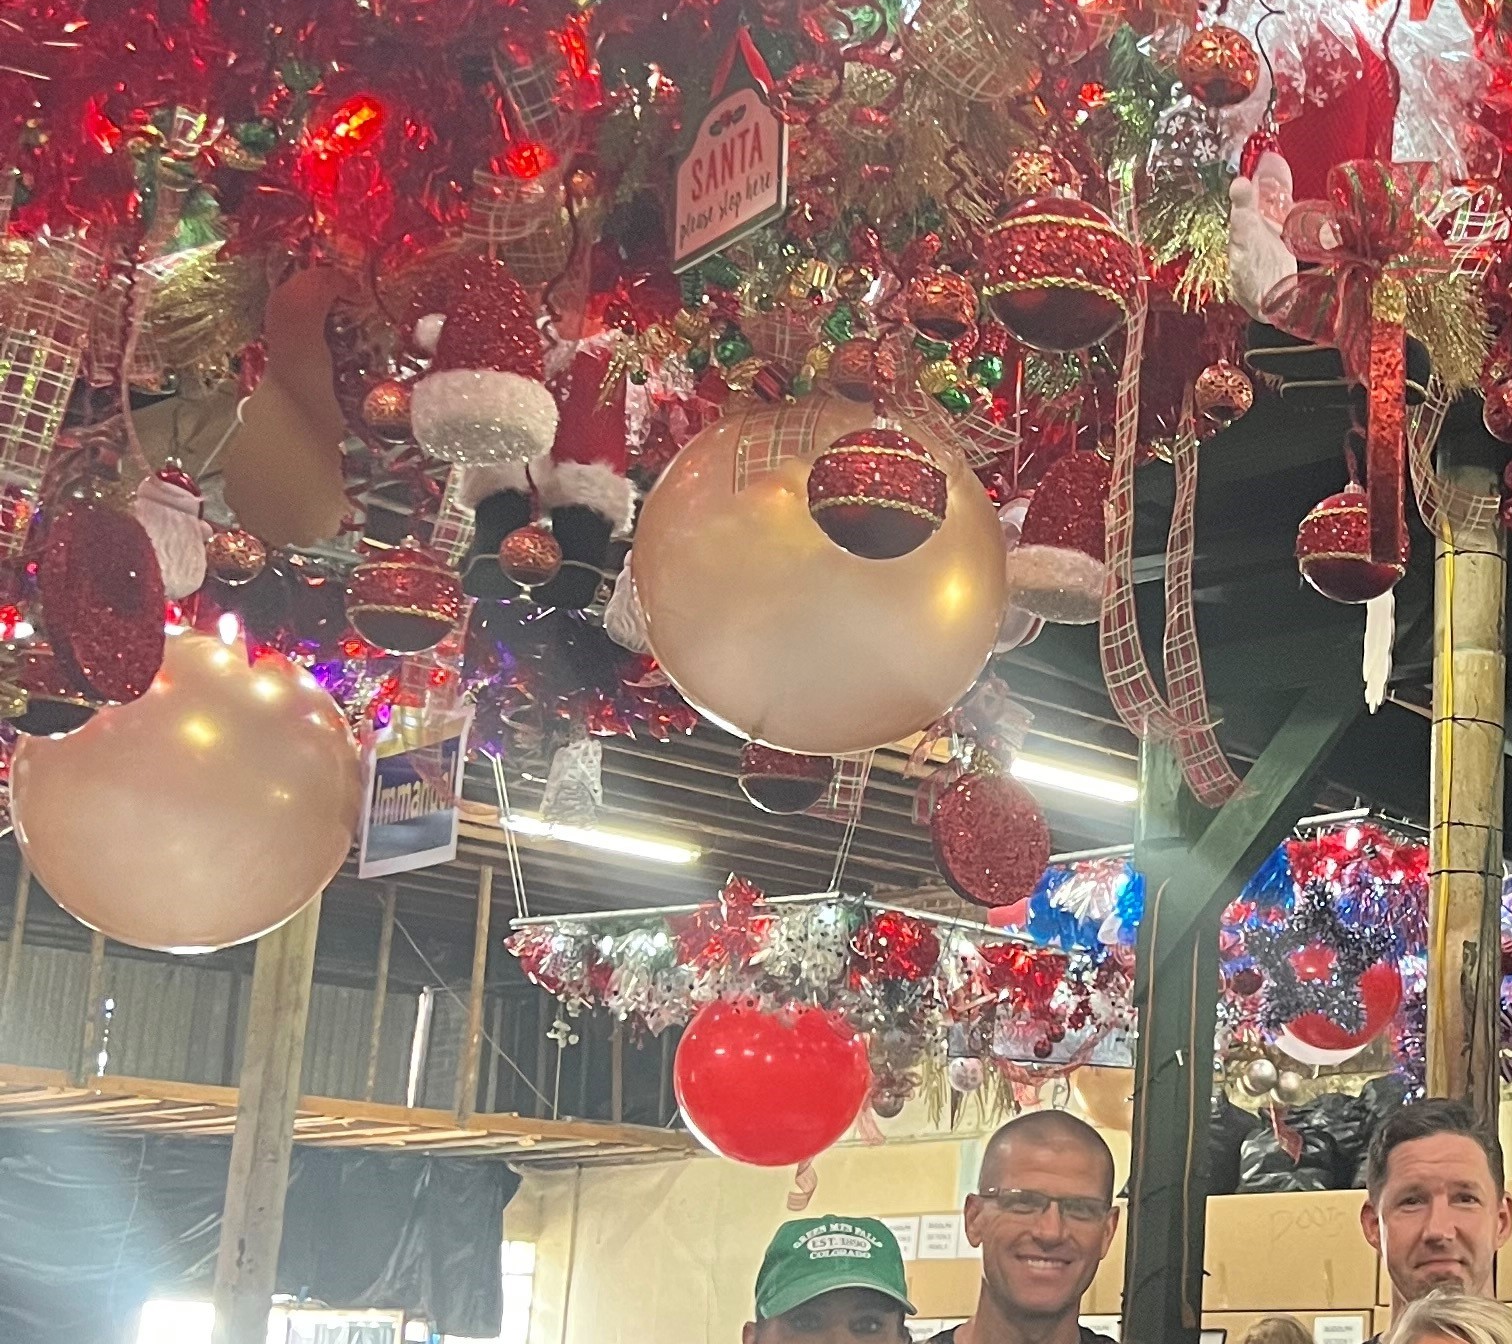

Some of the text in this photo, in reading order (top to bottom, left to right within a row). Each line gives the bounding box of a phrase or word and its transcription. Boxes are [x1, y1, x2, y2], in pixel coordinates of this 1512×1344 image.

[691, 121, 764, 203] SANTA
[679, 171, 771, 251] please stop here
